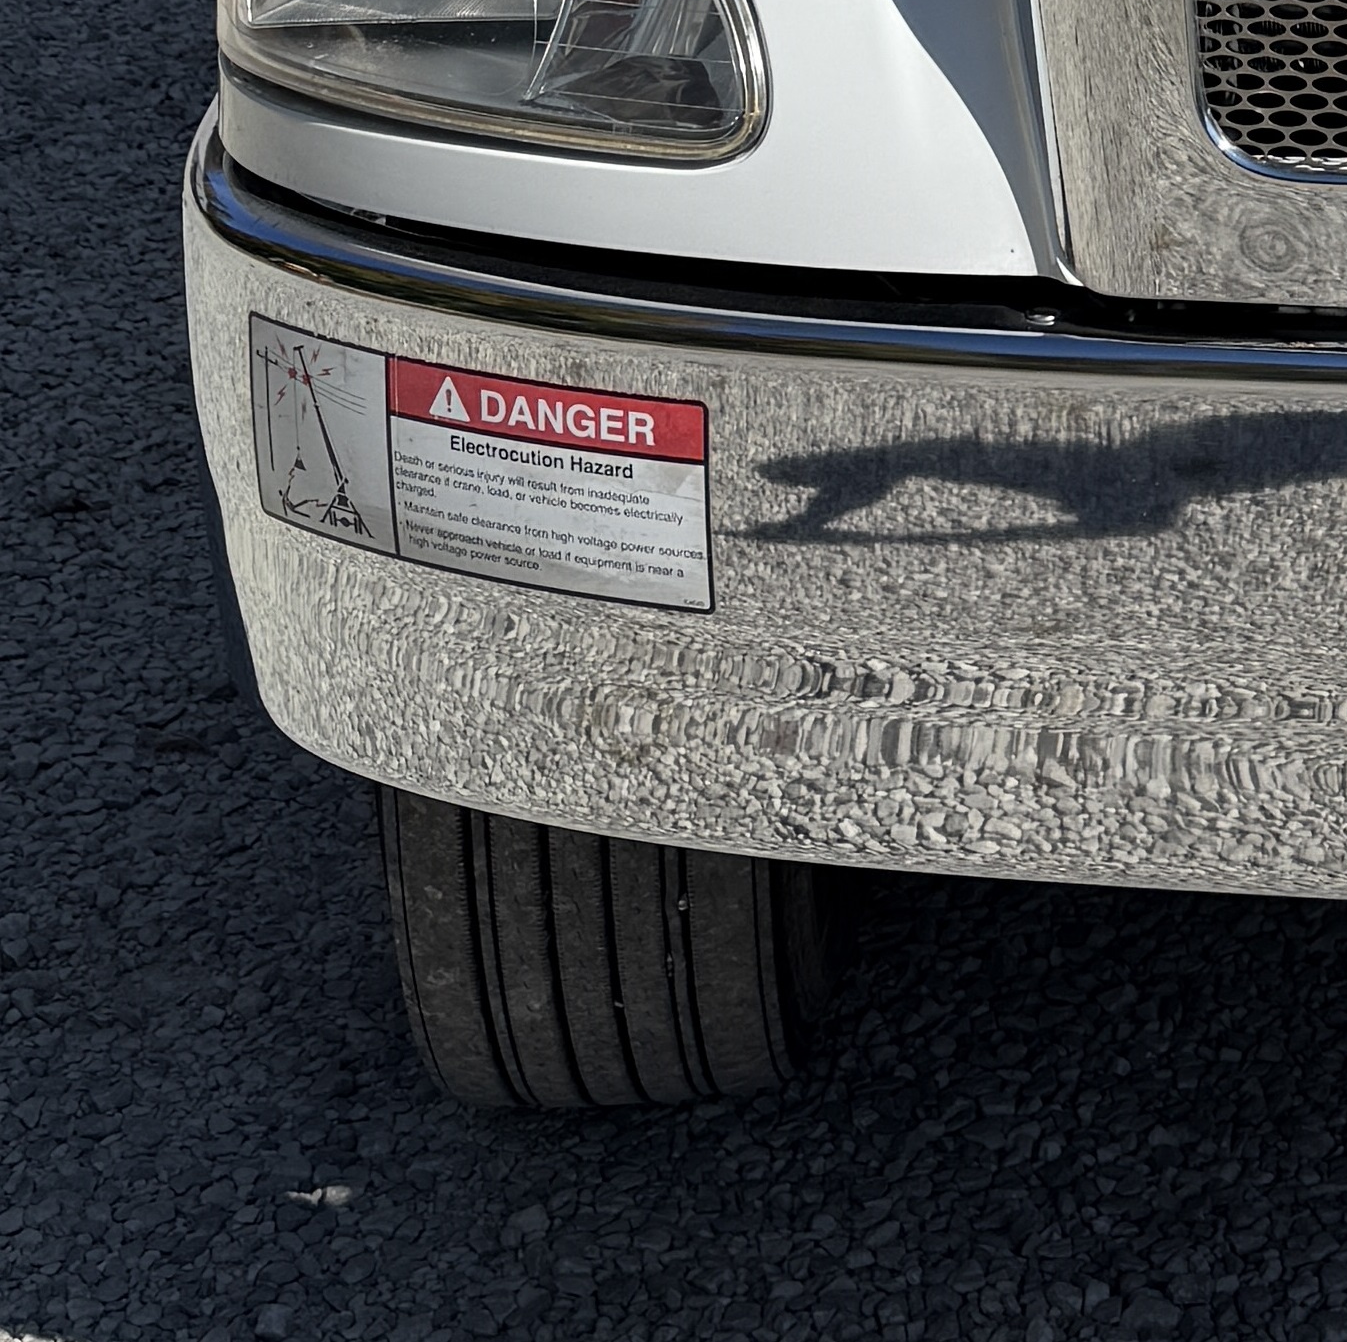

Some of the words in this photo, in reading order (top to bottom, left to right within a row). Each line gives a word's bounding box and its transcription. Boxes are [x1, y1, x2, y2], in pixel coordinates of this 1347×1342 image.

[480, 389, 656, 447] DANGER
[394, 450, 423, 467] Death
[425, 460, 435, 470] or
[438, 463, 475, 478] serious
[476, 468, 505, 486] injury
[507, 476, 525, 487] will
[527, 479, 558, 492] result
[560, 482, 585, 497] from
[587, 487, 650, 505] inadequate
[450, 435, 564, 470] Electrocution
[570, 455, 633, 480] Hazard
[394, 465, 442, 486] clearance
[487, 485, 513, 501] load,
[515, 492, 526, 502] or
[529, 493, 568, 509] vehicle
[570, 500, 621, 516] becomes
[624, 507, 684, 526] electrically
[396, 479, 437, 498] charged.
[405, 519, 435, 535] Never
[437, 528, 483, 547] approach
[485, 538, 523, 555] vehicle
[525, 547, 536, 557] or
[538, 546, 562, 561] load
[574, 554, 633, 573] equipment
[648, 563, 674, 577] near
[676, 568, 685, 579] a
[408, 533, 430, 549] high
[431, 540, 468, 557] voltage
[470, 549, 502, 563] power
[471, 516, 521, 535] clearance
[524, 525, 549, 540] from
[551, 529, 575, 545] high
[577, 534, 617, 552] voltage
[621, 541, 656, 555] power
